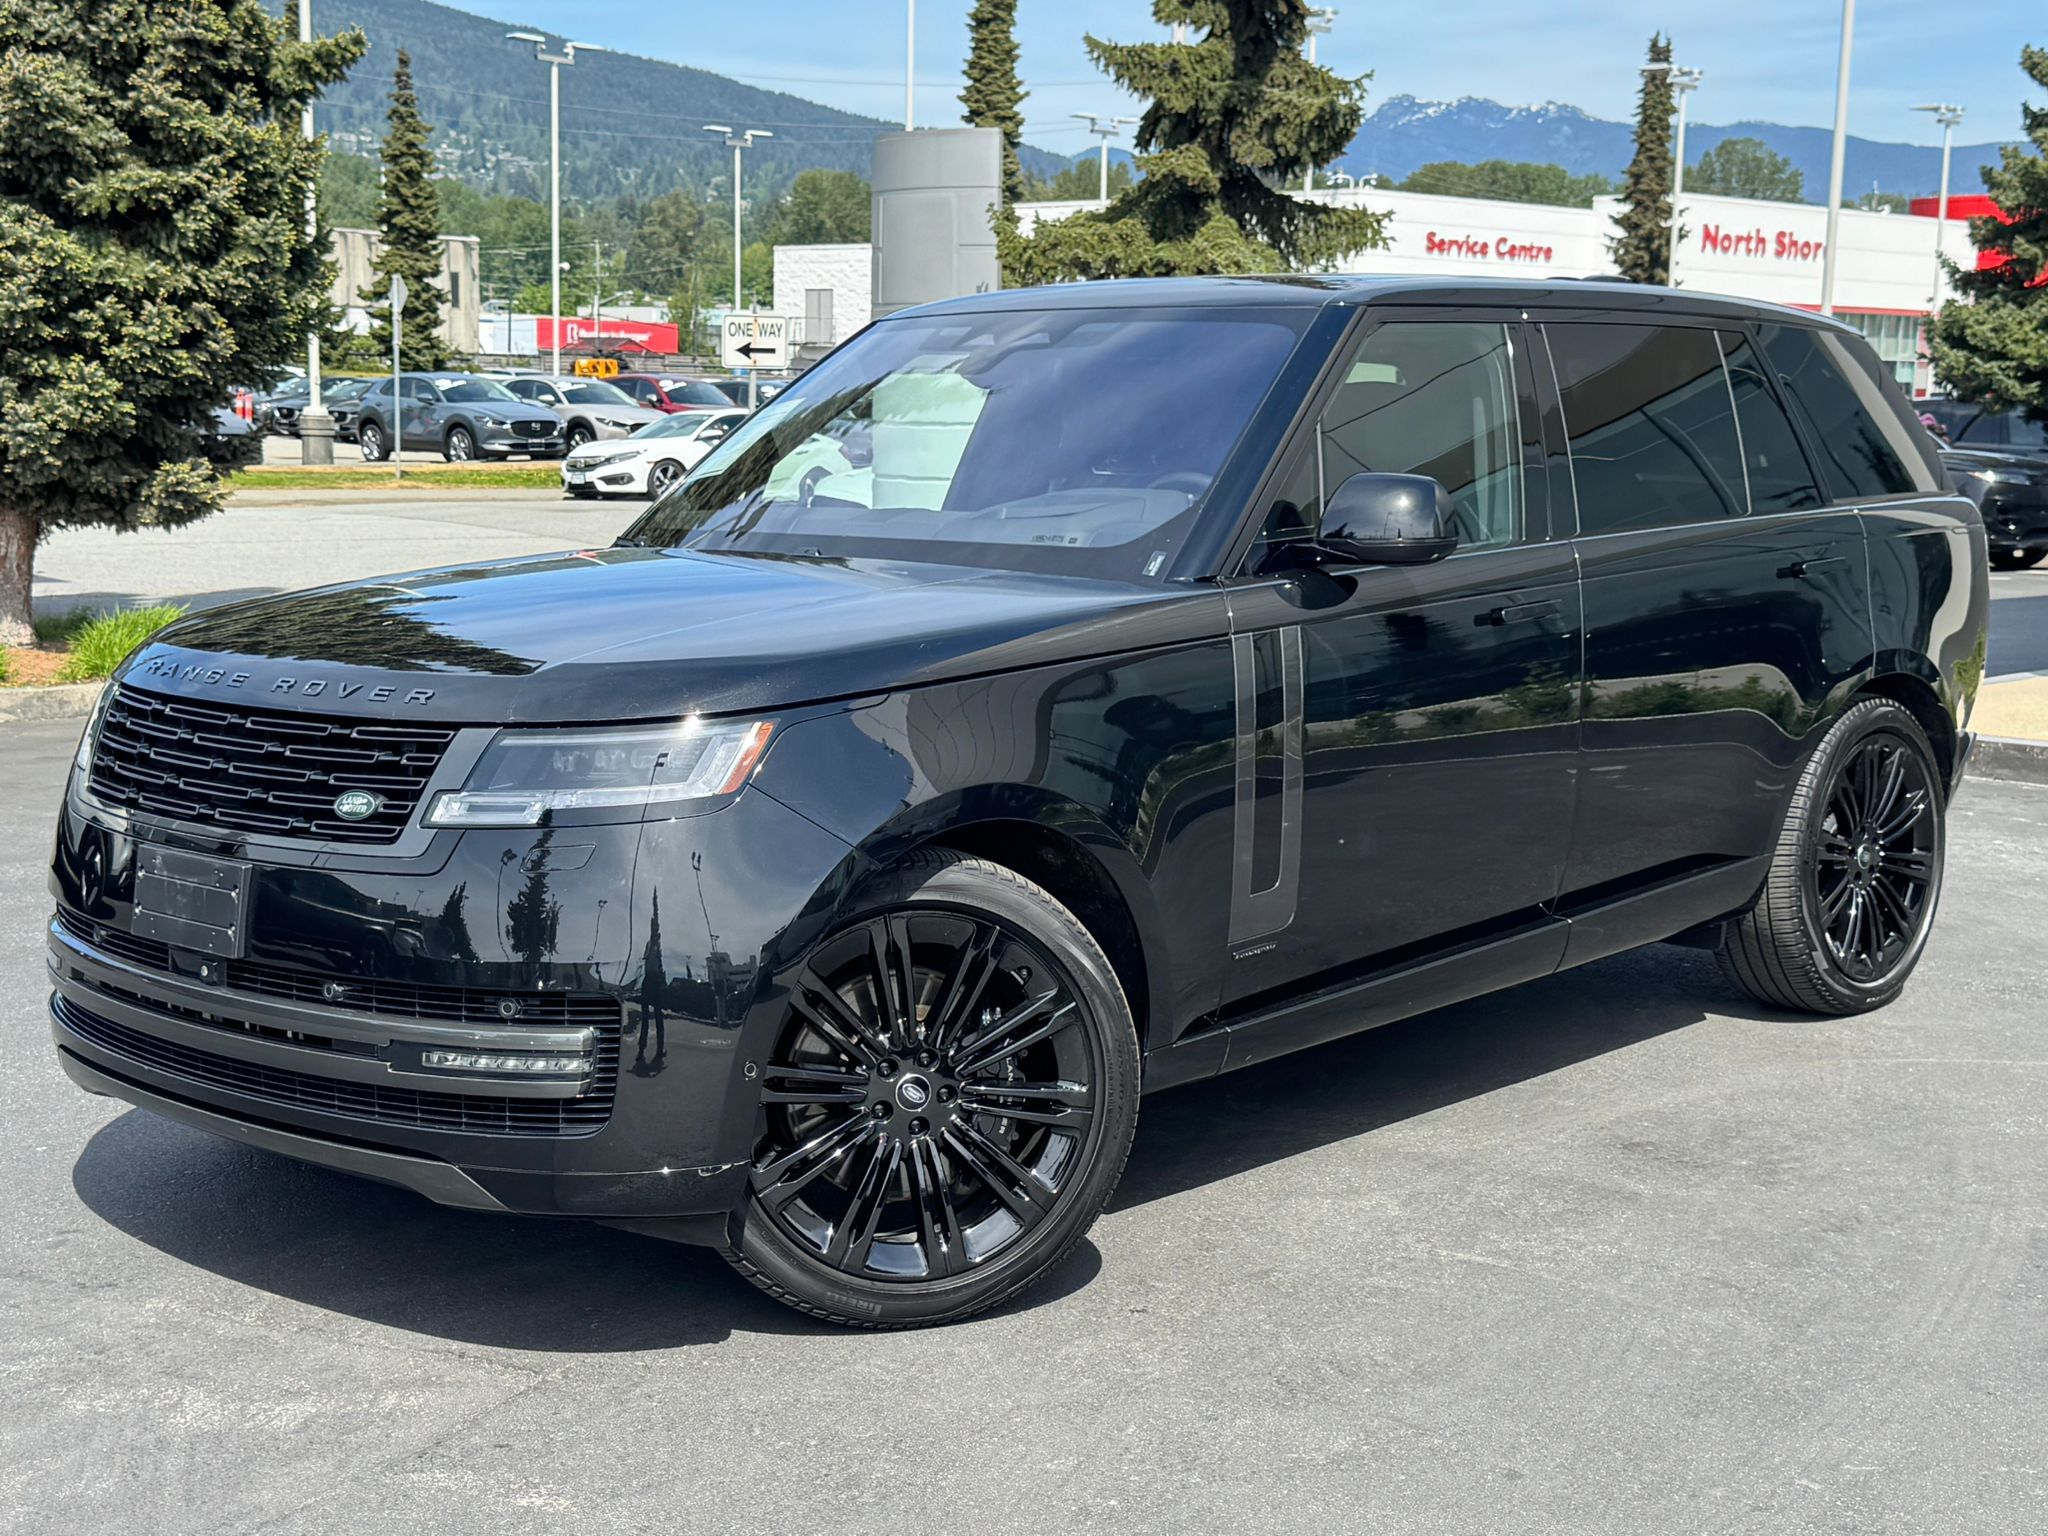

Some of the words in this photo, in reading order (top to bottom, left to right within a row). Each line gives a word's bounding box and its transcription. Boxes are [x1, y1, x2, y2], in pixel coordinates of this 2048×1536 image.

[1426, 231, 1489, 259] Service
[1495, 236, 1552, 262] Centre
[1701, 223, 1766, 258] North
[1774, 230, 1827, 262] Shor
[728, 321, 753, 337] ONE
[757, 322, 783, 338] WAY
[145, 659, 251, 689] RANGE
[270, 676, 436, 706] ROVER
